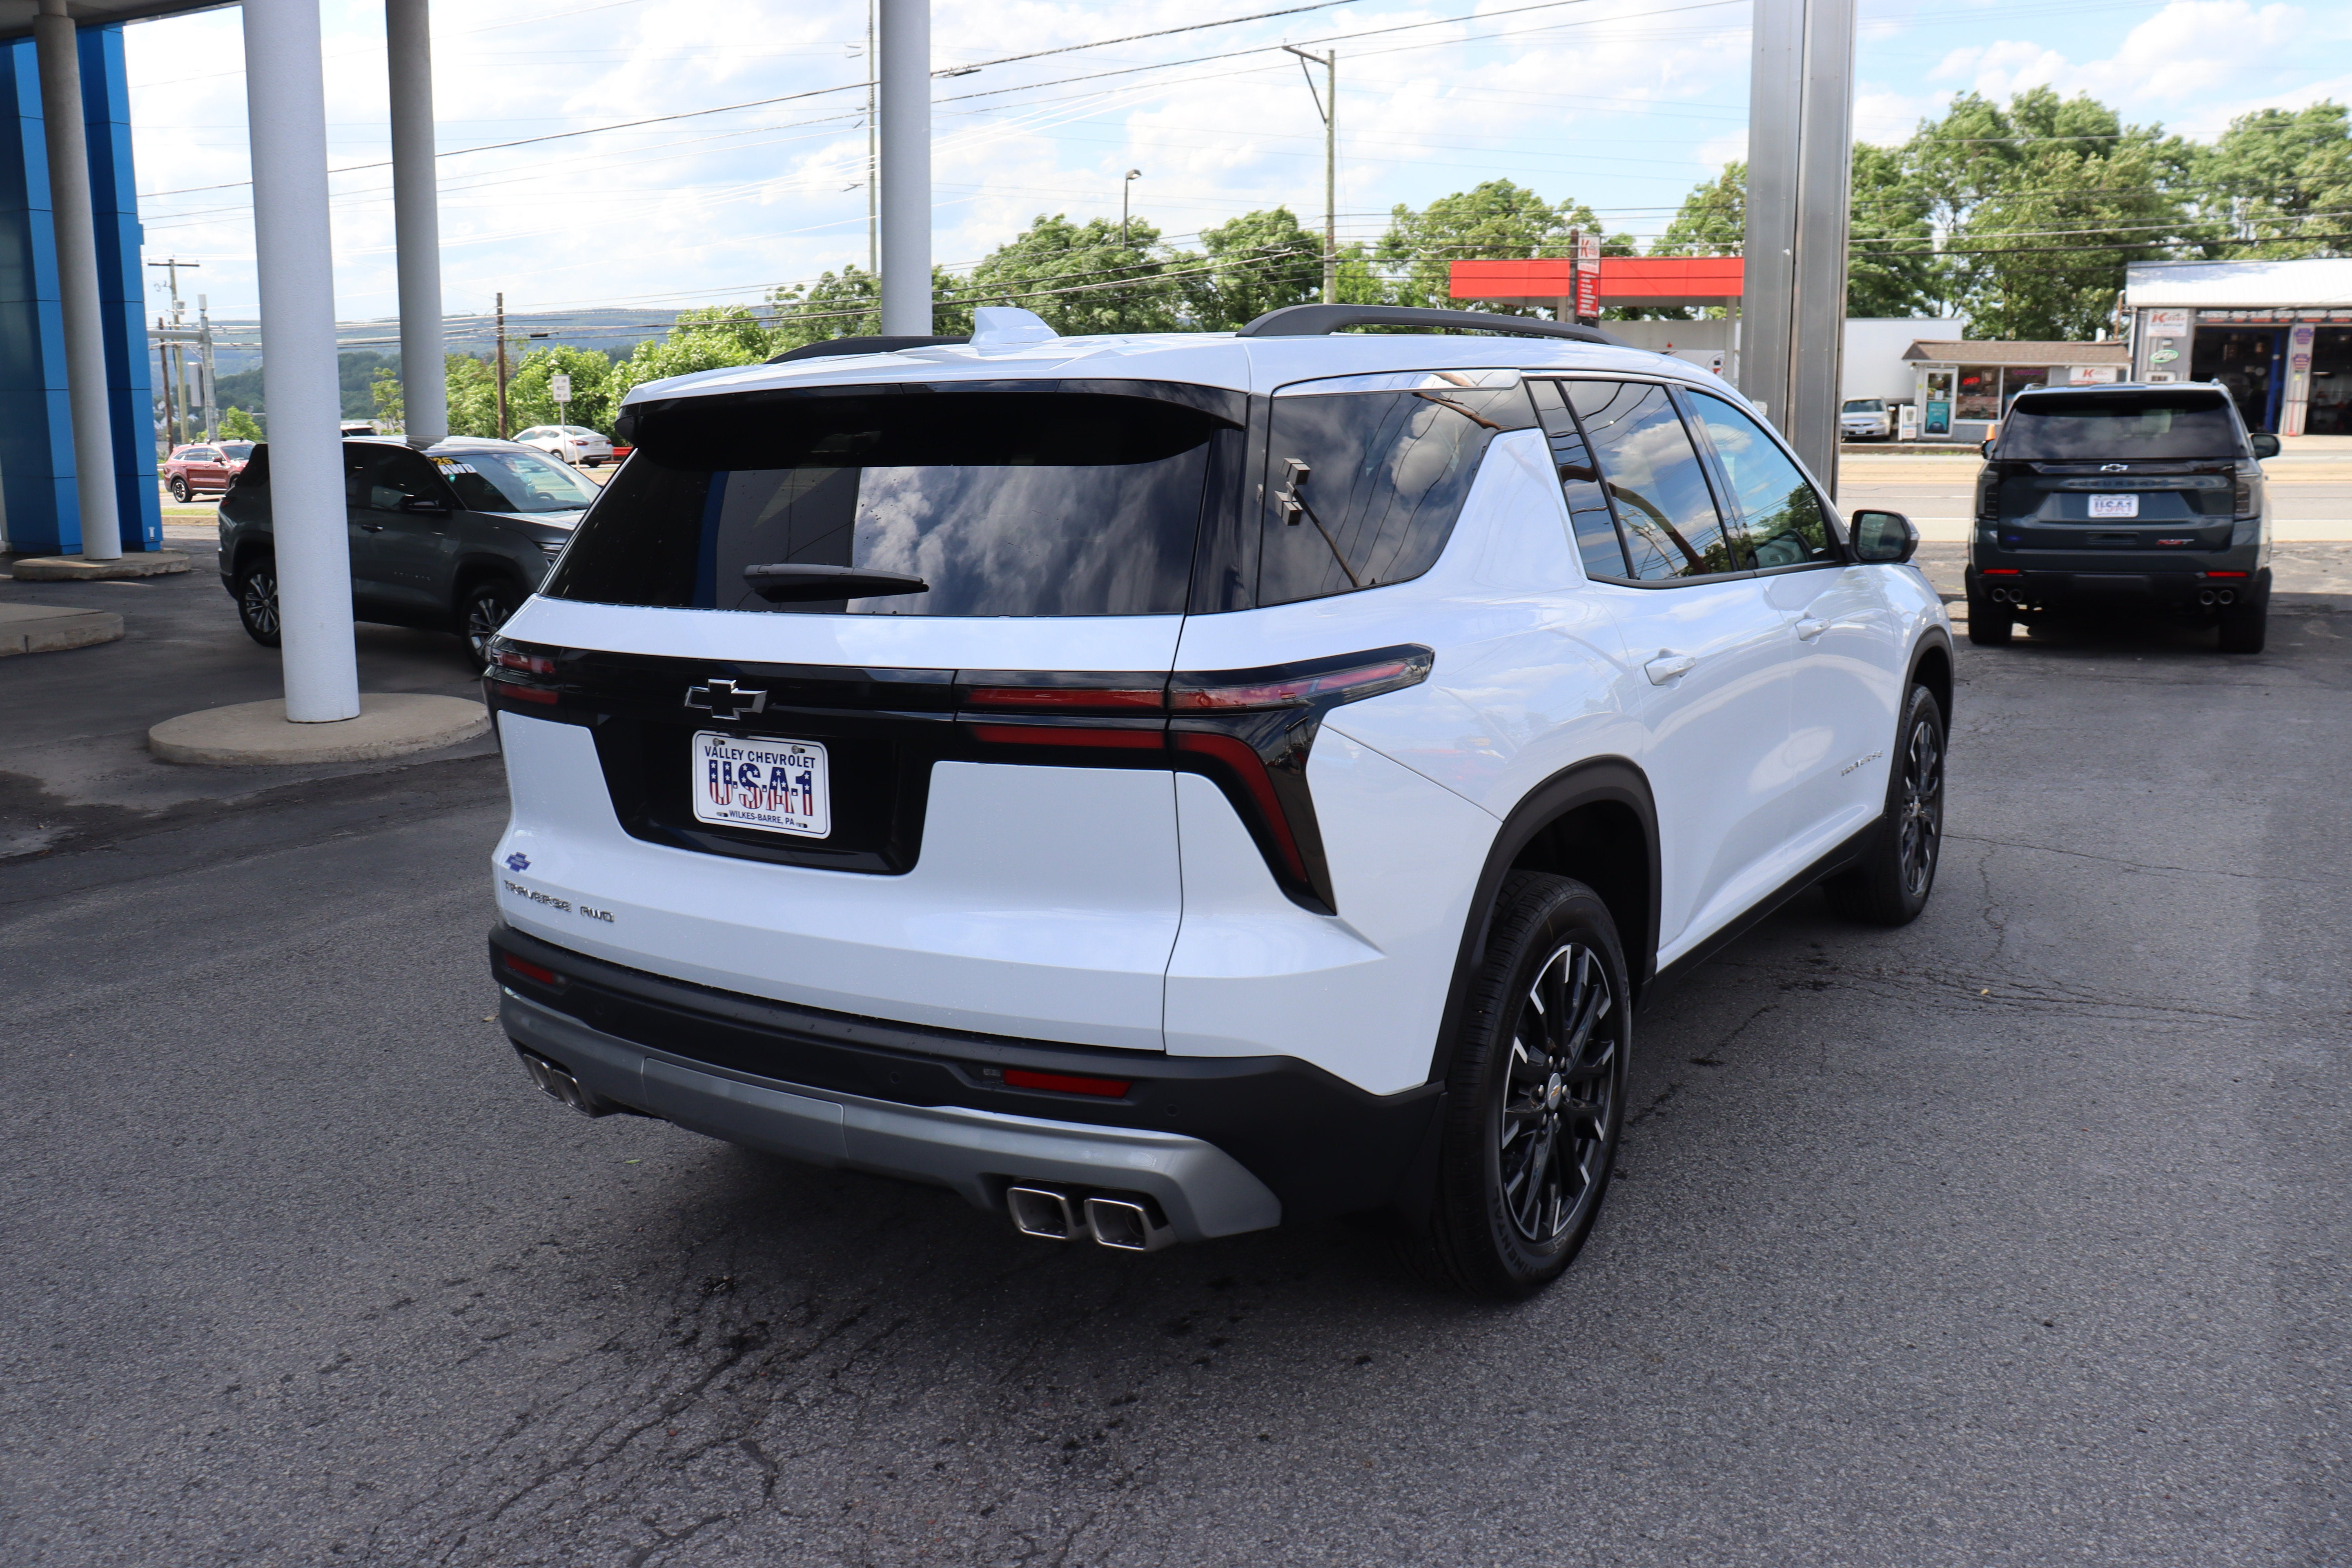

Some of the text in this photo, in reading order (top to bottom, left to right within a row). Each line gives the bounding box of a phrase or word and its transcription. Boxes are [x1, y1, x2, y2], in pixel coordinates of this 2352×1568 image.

[437, 463, 477, 475] AWD
[704, 746, 815, 768] VALLEY CHEVROLET
[785, 817, 795, 826] PA
[504, 880, 615, 922] TRAVERSE AWD
